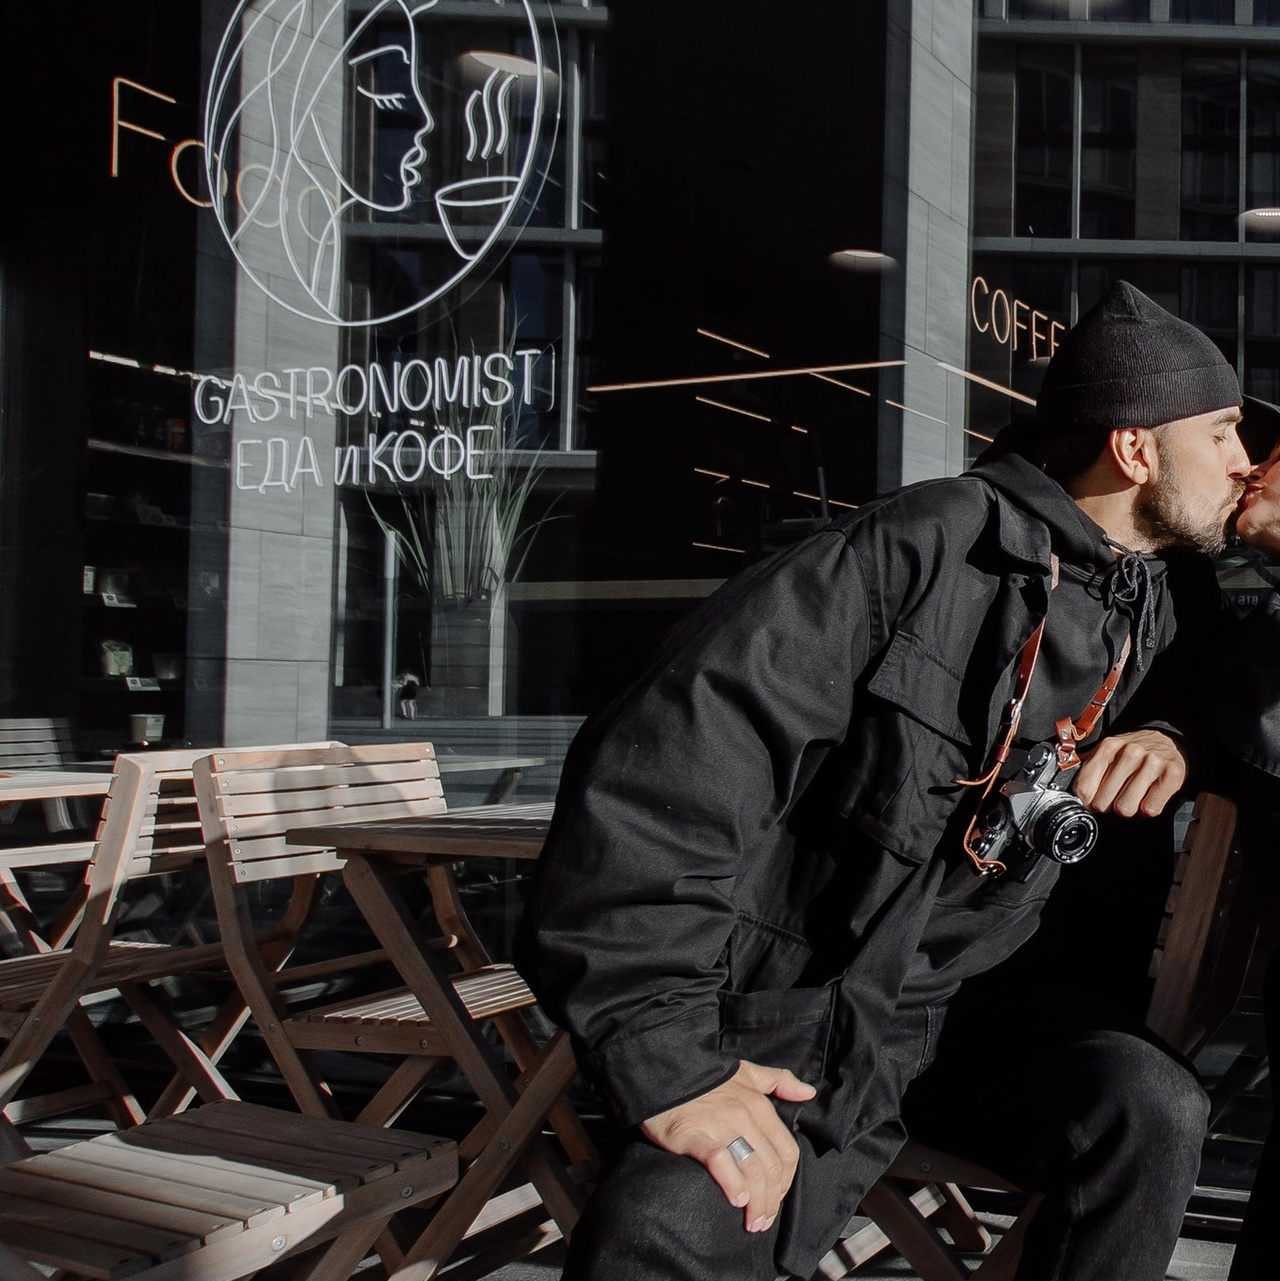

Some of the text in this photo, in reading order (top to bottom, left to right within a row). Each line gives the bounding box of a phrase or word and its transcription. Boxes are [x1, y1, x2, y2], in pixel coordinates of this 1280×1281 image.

[971, 276, 1066, 361] COFFE
[193, 348, 542, 424] GASTRONOMIST
[236, 436, 320, 494] ЕДА
